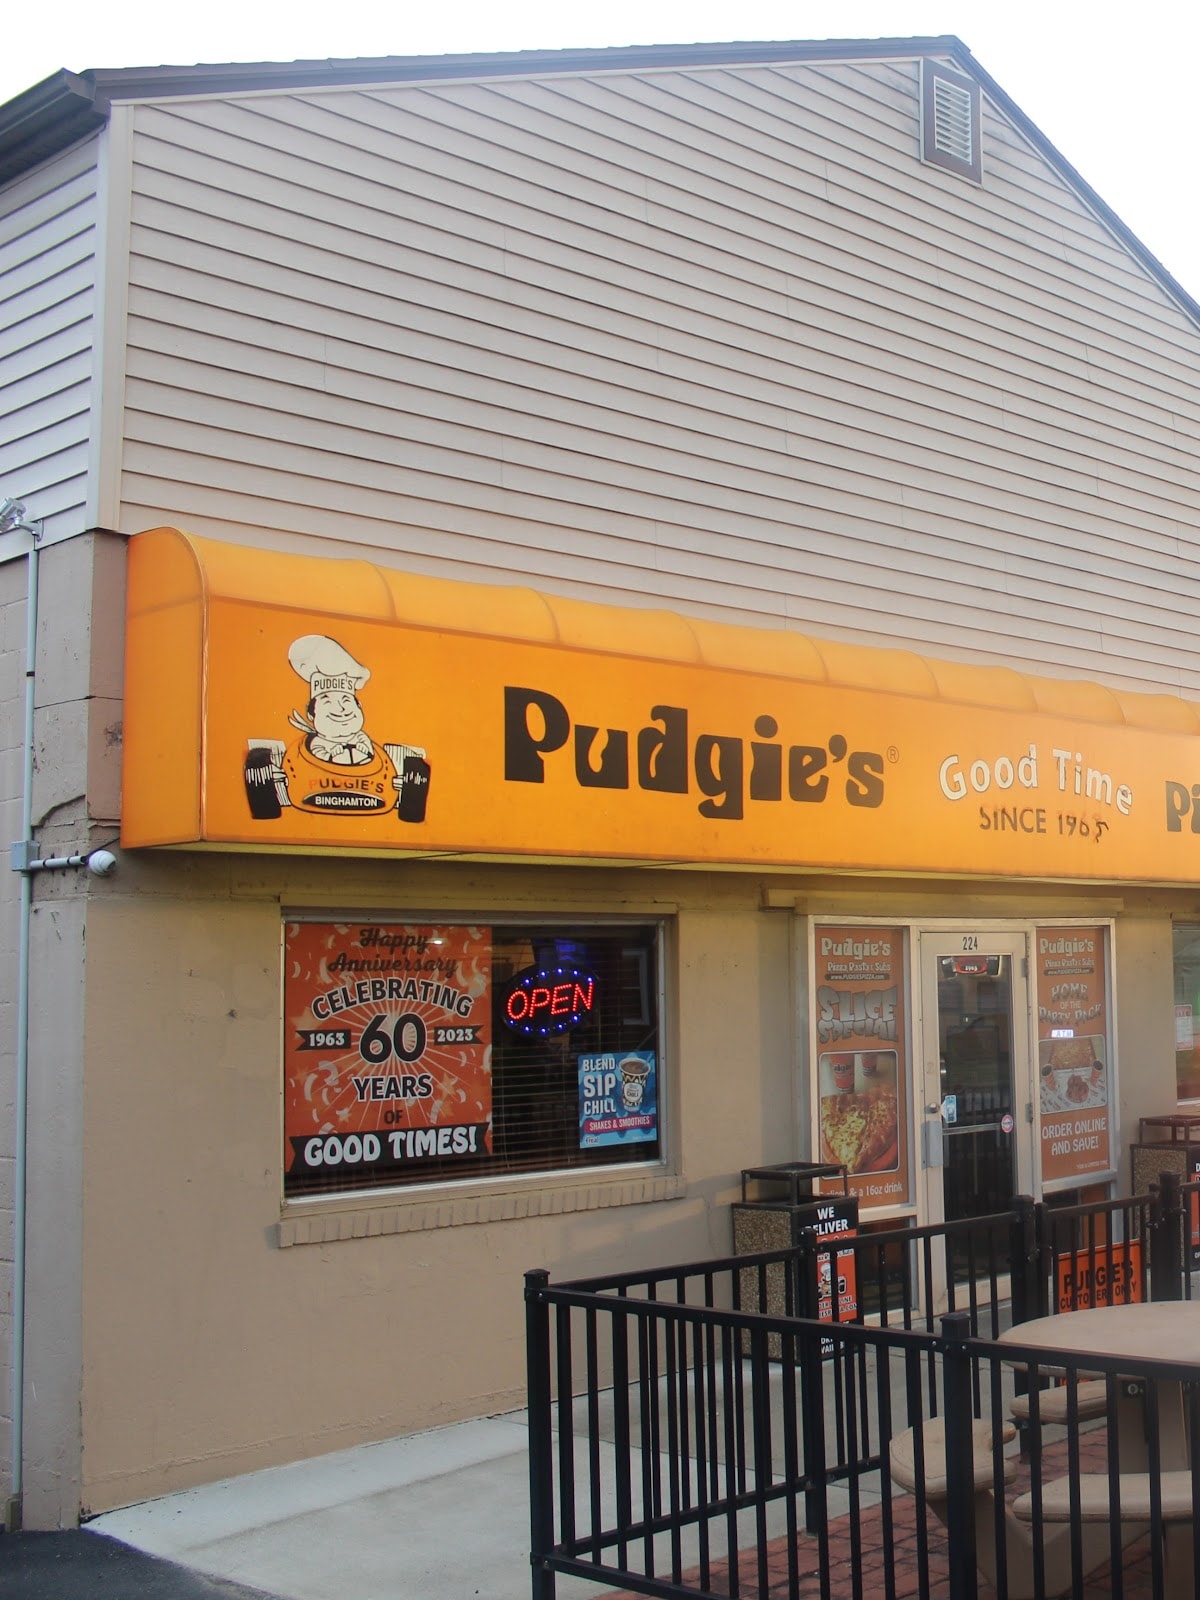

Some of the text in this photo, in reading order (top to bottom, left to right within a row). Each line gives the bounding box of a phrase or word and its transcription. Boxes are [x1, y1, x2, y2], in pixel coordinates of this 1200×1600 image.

[313, 678, 353, 691] PUDGIE'S
[939, 743, 1134, 816] Good Time
[315, 796, 378, 807] BINGHAMTON
[979, 805, 1047, 834] SINCE
[359, 927, 428, 953] Happy
[820, 937, 891, 960] Pudgie's
[962, 936, 978, 950] 224
[1039, 937, 1095, 956] Pudgie's
[327, 952, 458, 978] Anniversary
[312, 977, 474, 1020] CELEBRATING
[507, 982, 593, 1019] OPEN
[817, 984, 898, 1022] SLICE
[309, 1013, 474, 1064] 1963 60 2023
[582, 1057, 616, 1072] BLEND
[353, 1073, 434, 1102] YEARS
[583, 1073, 616, 1098] SIP
[384, 1110, 403, 1124] OF
[583, 1098, 617, 1115] CHILL
[589, 1120, 612, 1131] SHAKES
[619, 1115, 650, 1128] SMOOTHIES
[1042, 1117, 1106, 1139] ORDER ONLINE
[304, 1126, 477, 1166] GOOD TIMES!
[1051, 1135, 1099, 1156] AND SAVE!
[866, 1185, 882, 1197] 16oz
[884, 1182, 903, 1194] drink
[817, 1206, 835, 1220] WE
